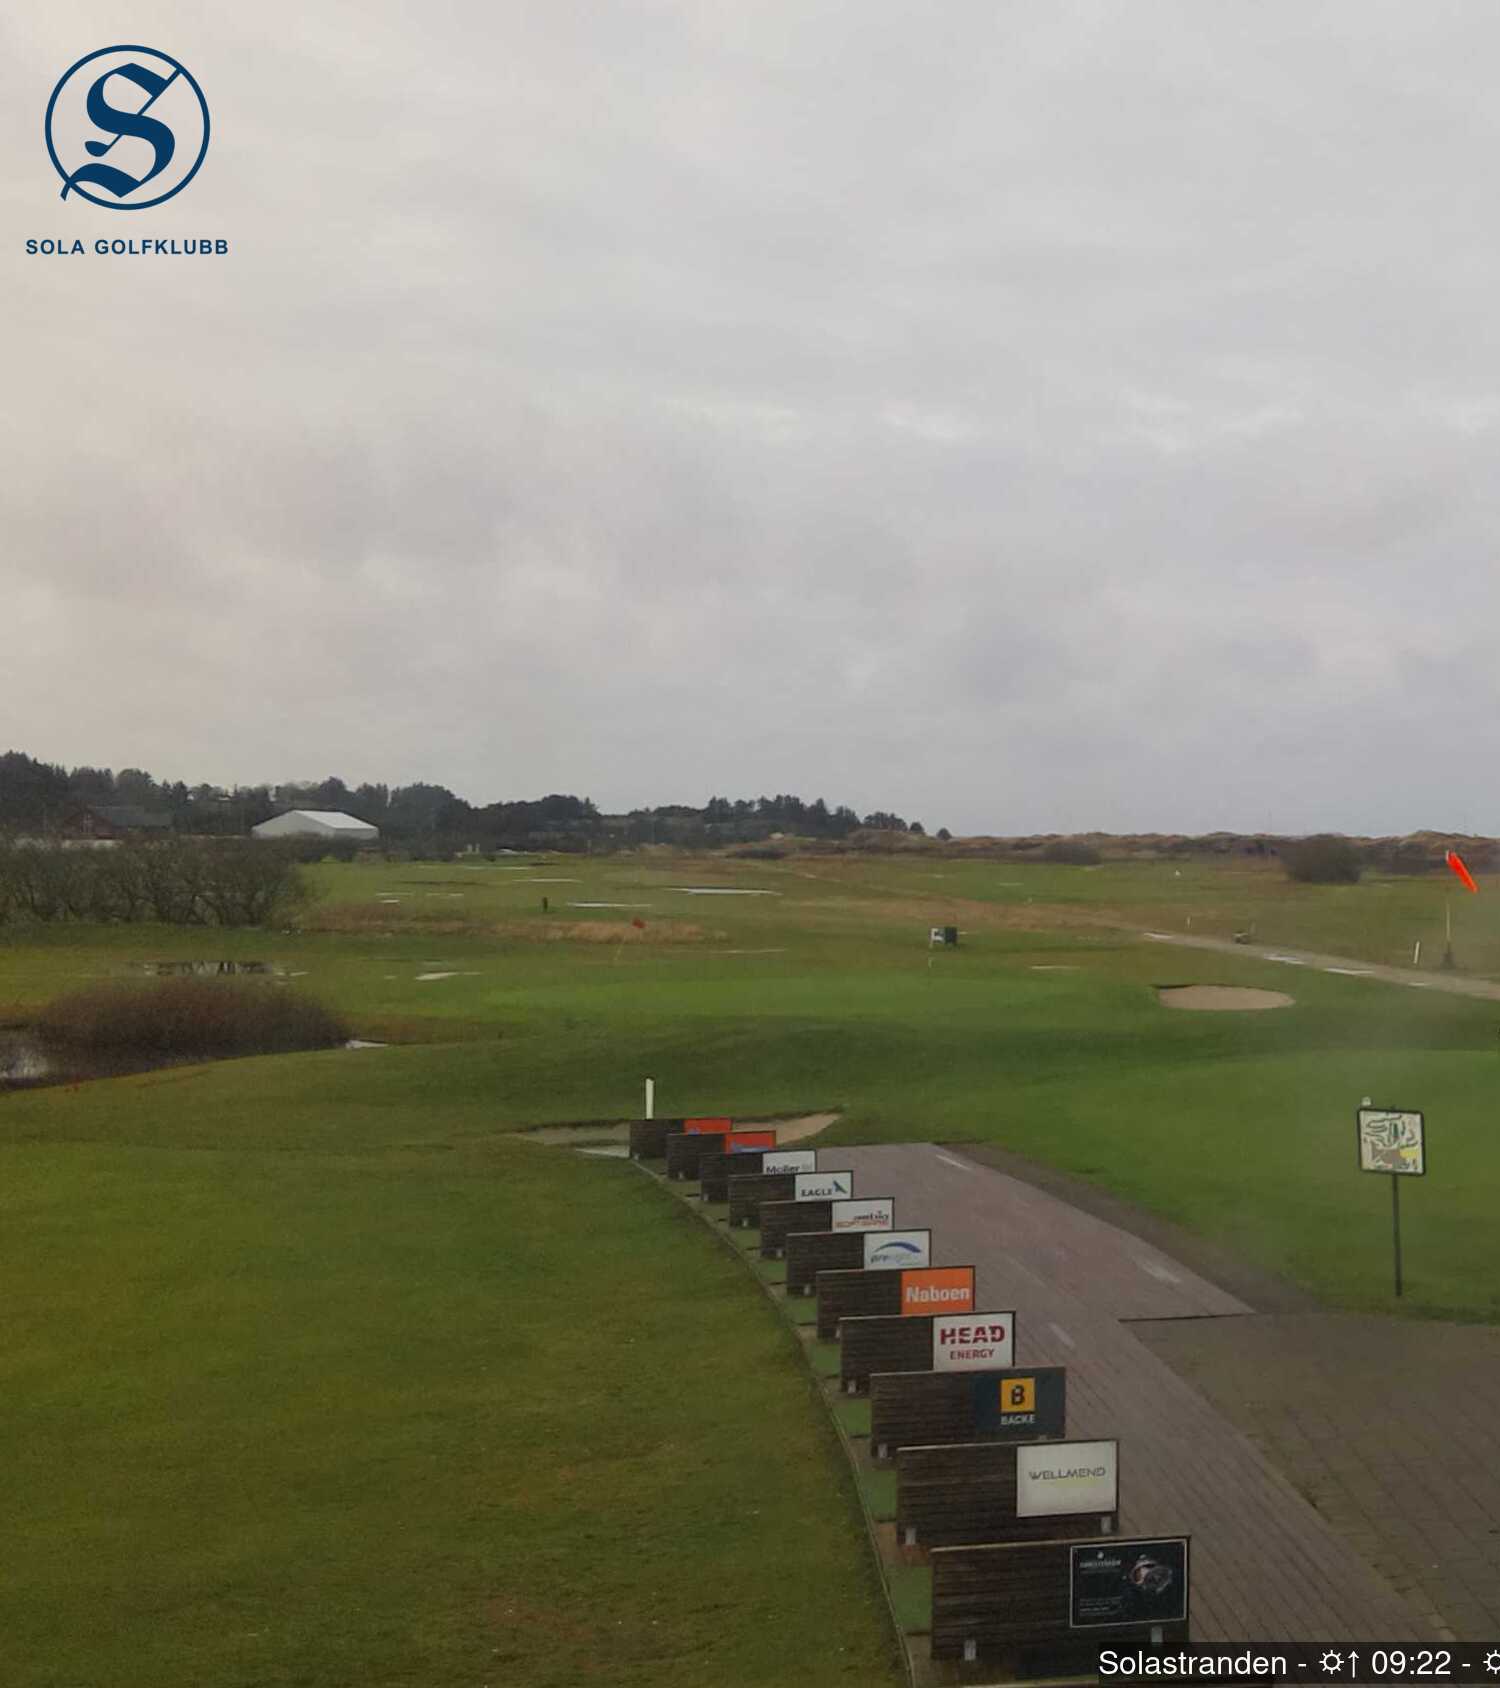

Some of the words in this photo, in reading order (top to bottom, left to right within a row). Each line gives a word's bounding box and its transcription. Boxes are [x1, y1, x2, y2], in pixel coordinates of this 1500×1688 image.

[801, 1188, 833, 1197] EAGLE
[906, 1286, 970, 1302] Naboen
[940, 1325, 1005, 1345] HEAD
[950, 1349, 995, 1360] ENERGY
[1011, 1384, 1026, 1405] B
[1028, 1467, 1106, 1480] WELLMEND
